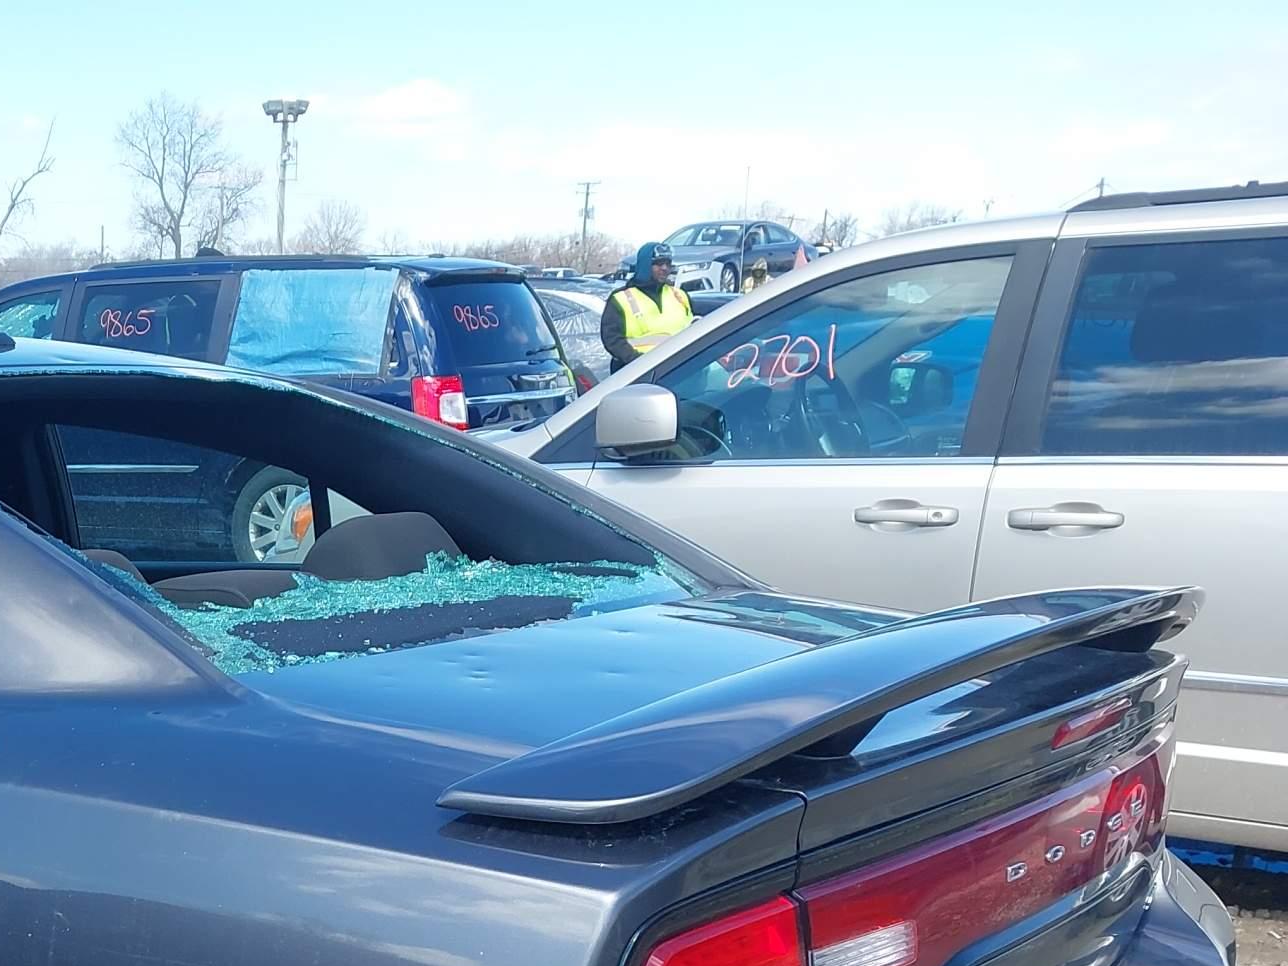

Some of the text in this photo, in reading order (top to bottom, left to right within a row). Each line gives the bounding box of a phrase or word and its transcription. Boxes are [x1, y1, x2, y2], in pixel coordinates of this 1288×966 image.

[100, 308, 156, 339] 9865
[453, 304, 499, 331] 9865
[722, 323, 836, 388] 2701
[1006, 799, 1144, 882] DODGE
